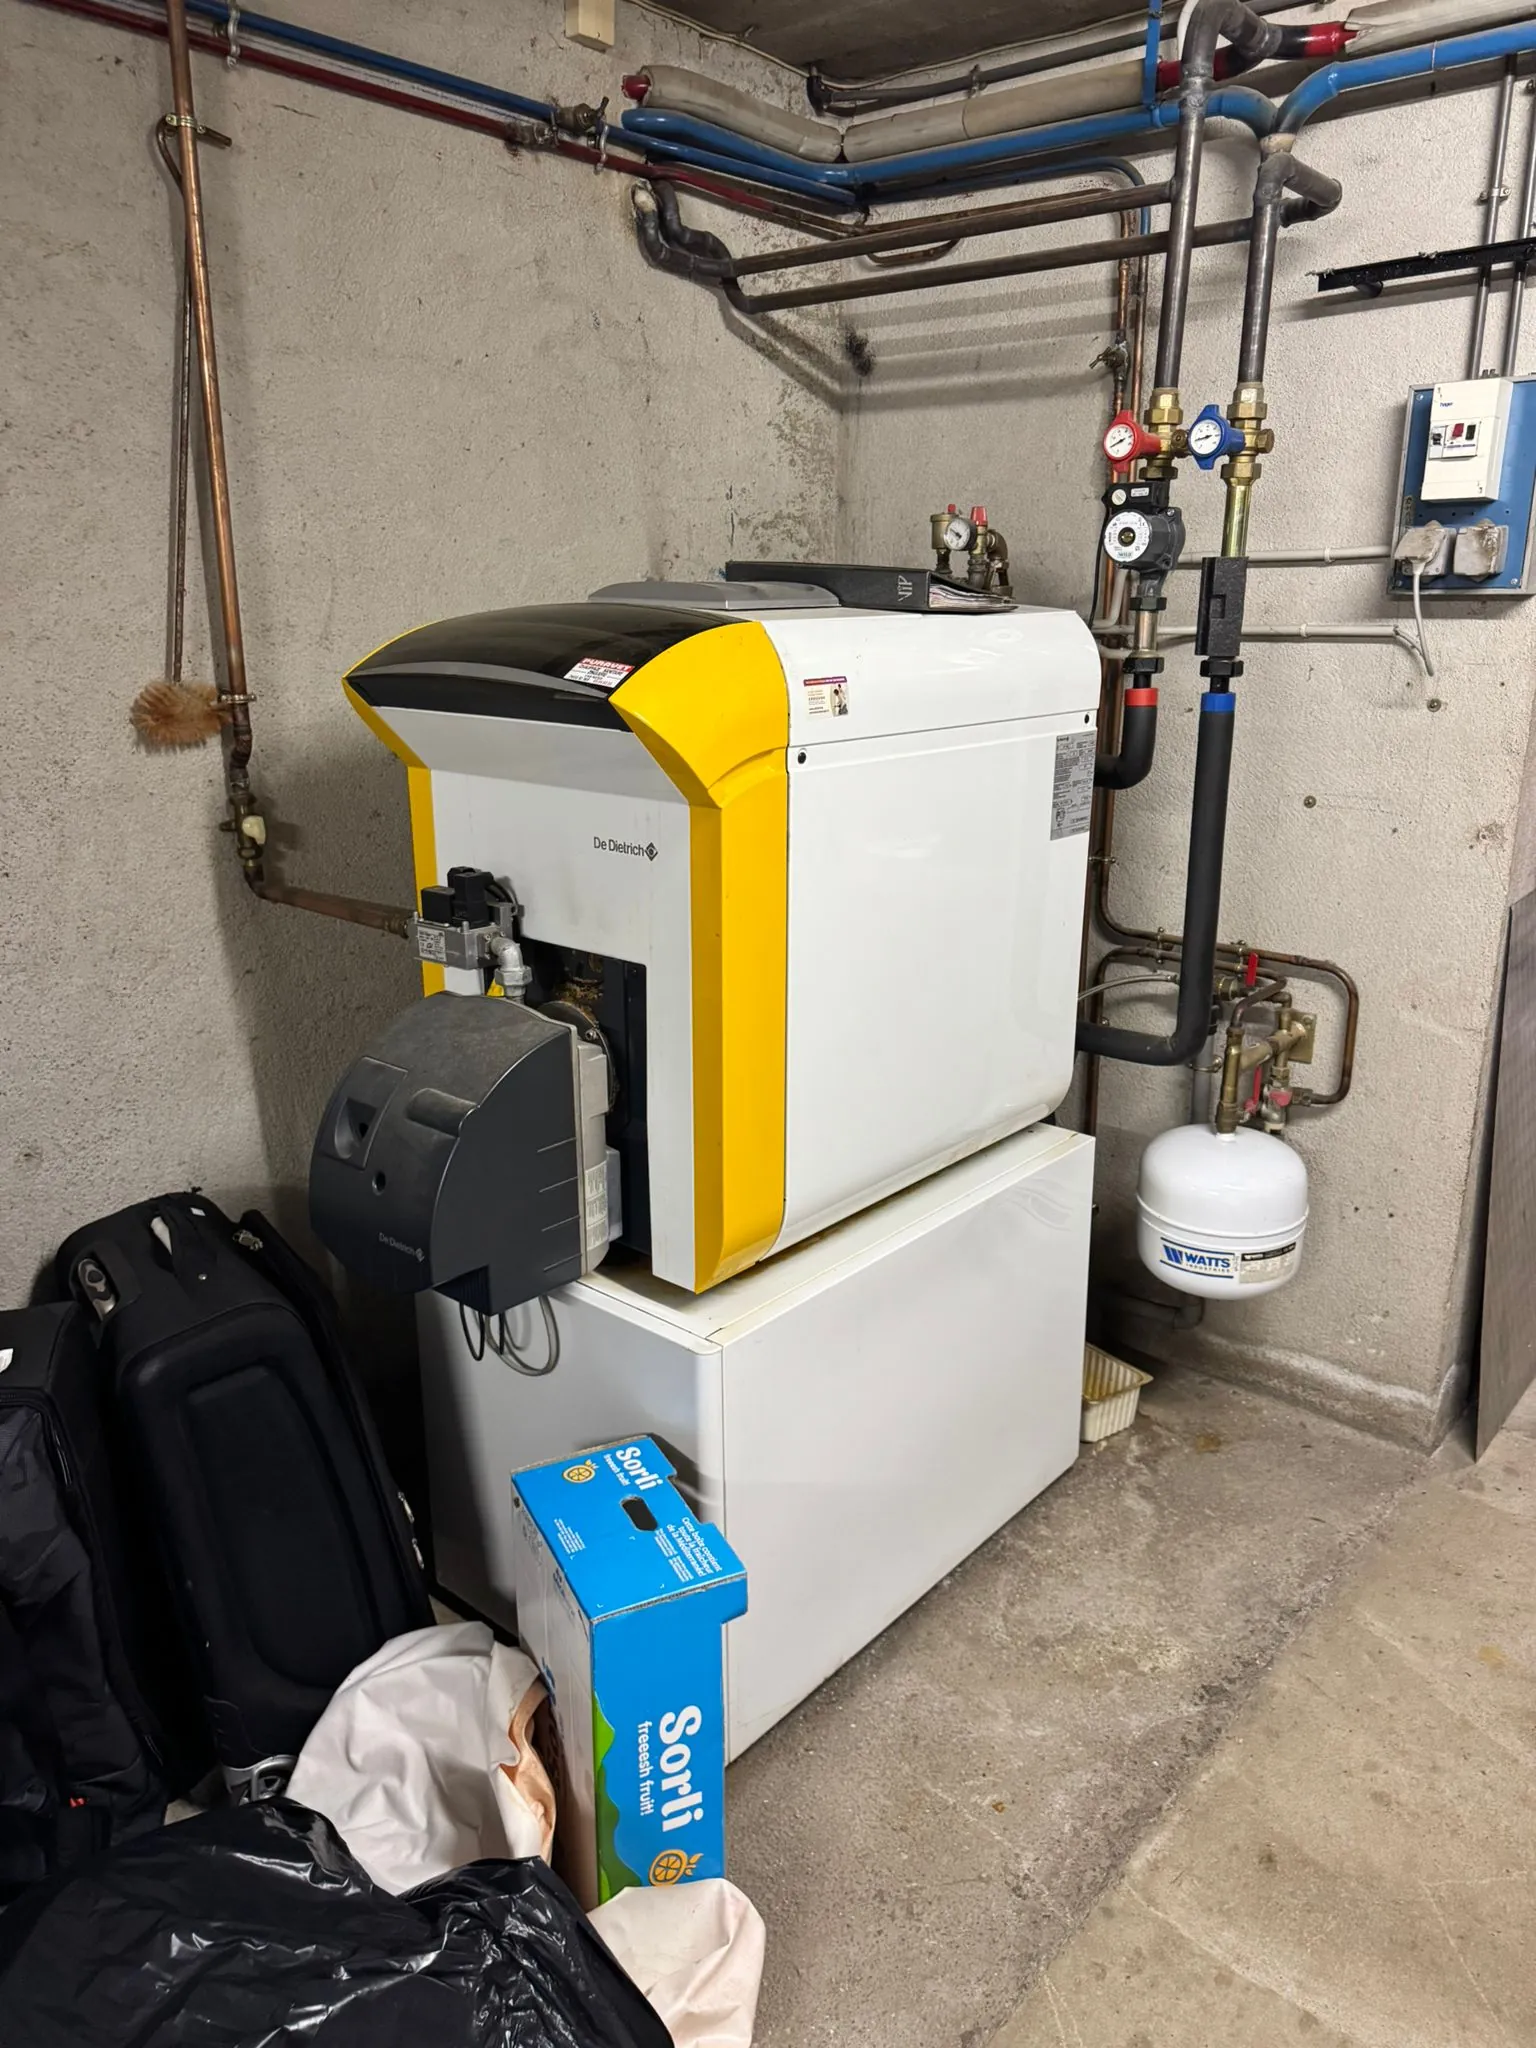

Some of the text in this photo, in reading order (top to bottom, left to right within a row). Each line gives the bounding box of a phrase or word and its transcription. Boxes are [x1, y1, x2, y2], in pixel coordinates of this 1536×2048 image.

[594, 836, 645, 856] De Dietrich
[1184, 1252, 1230, 1268] WATTS
[616, 1446, 663, 1491] Sorli
[637, 1720, 655, 1816] freeesh fruit!
[659, 1705, 704, 1832] Sorli
